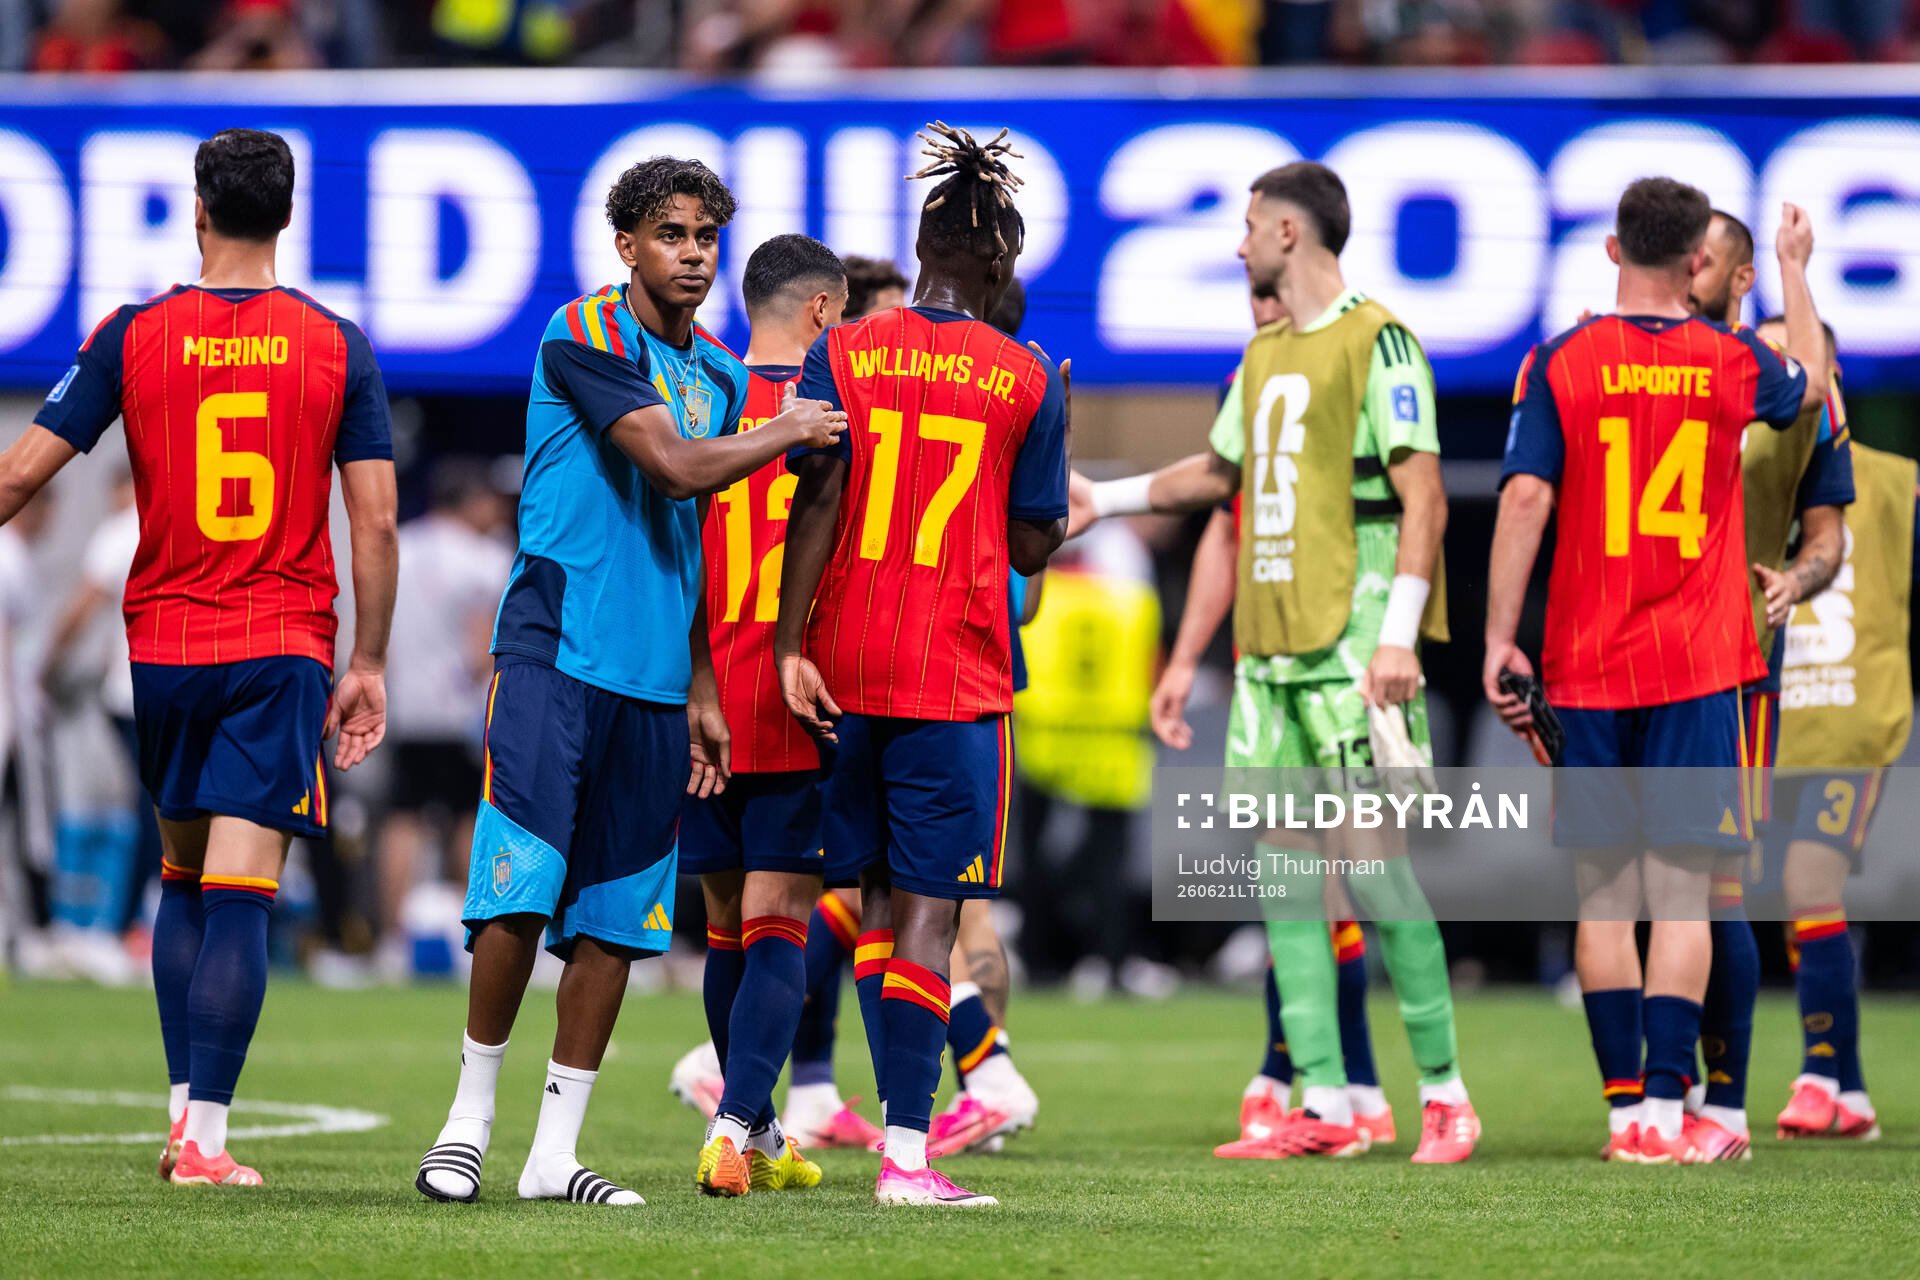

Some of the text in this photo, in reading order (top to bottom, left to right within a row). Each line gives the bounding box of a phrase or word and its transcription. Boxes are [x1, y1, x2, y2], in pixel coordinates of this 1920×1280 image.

[1099, 120, 1920, 355] 2026
[183, 335, 289, 366] MERINO
[848, 346, 1016, 405] WILLIAMS JR.
[1602, 364, 1713, 398] LAPORTE
[196, 391, 275, 542] 6
[859, 407, 987, 568] 17
[1598, 416, 1709, 559] 14
[1816, 778, 1857, 836] 3
